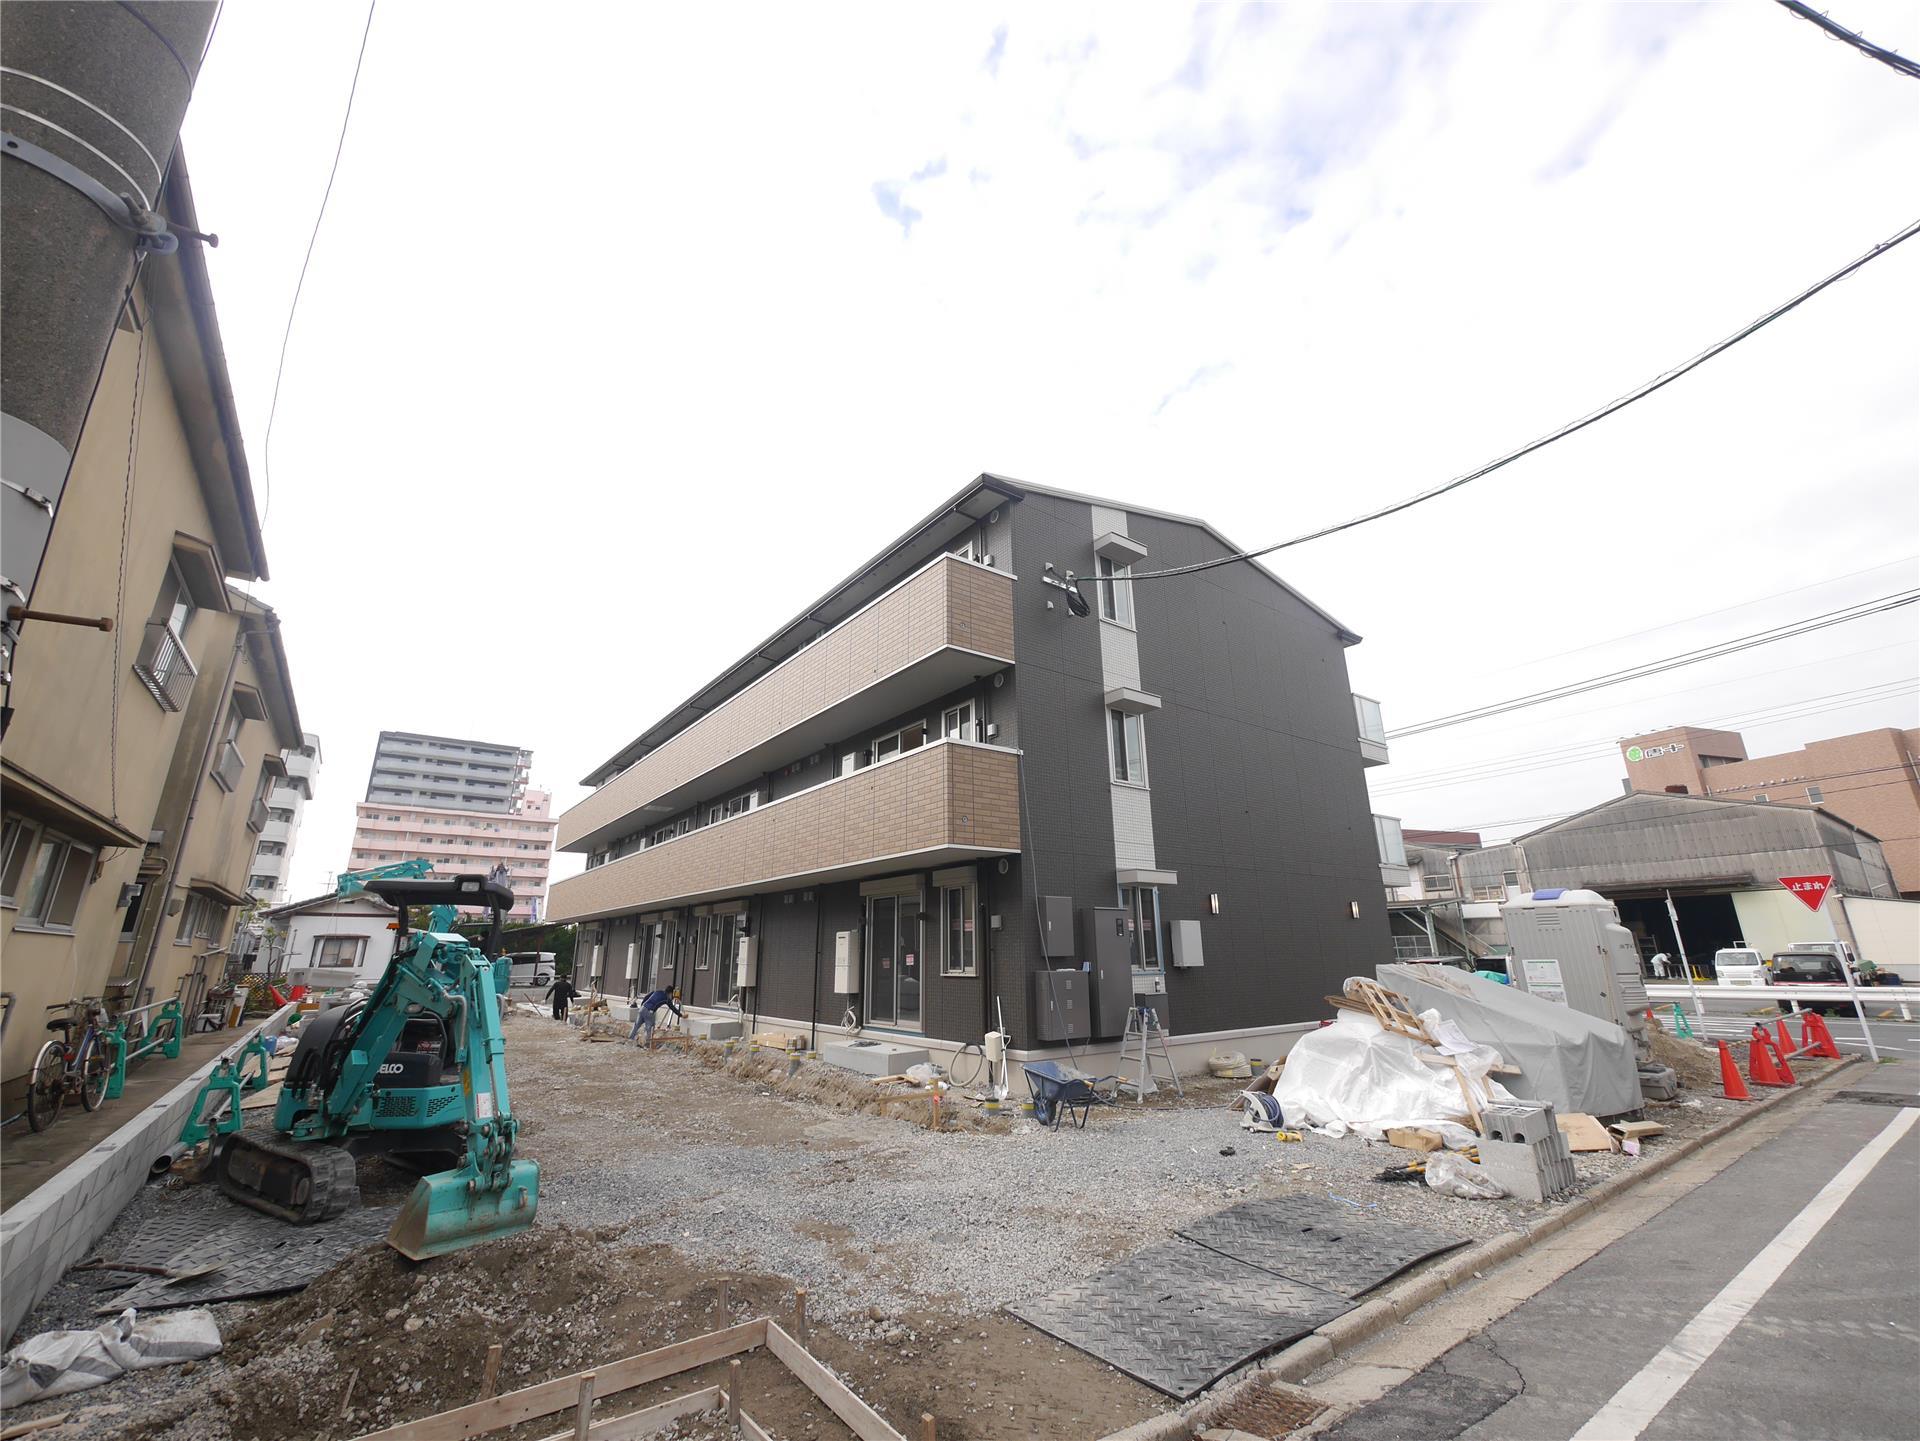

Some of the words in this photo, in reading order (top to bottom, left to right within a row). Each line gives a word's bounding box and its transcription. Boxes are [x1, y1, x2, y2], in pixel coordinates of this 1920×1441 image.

[1792, 881, 1825, 891] 止まれ
[377, 1063, 404, 1074] ELCO
